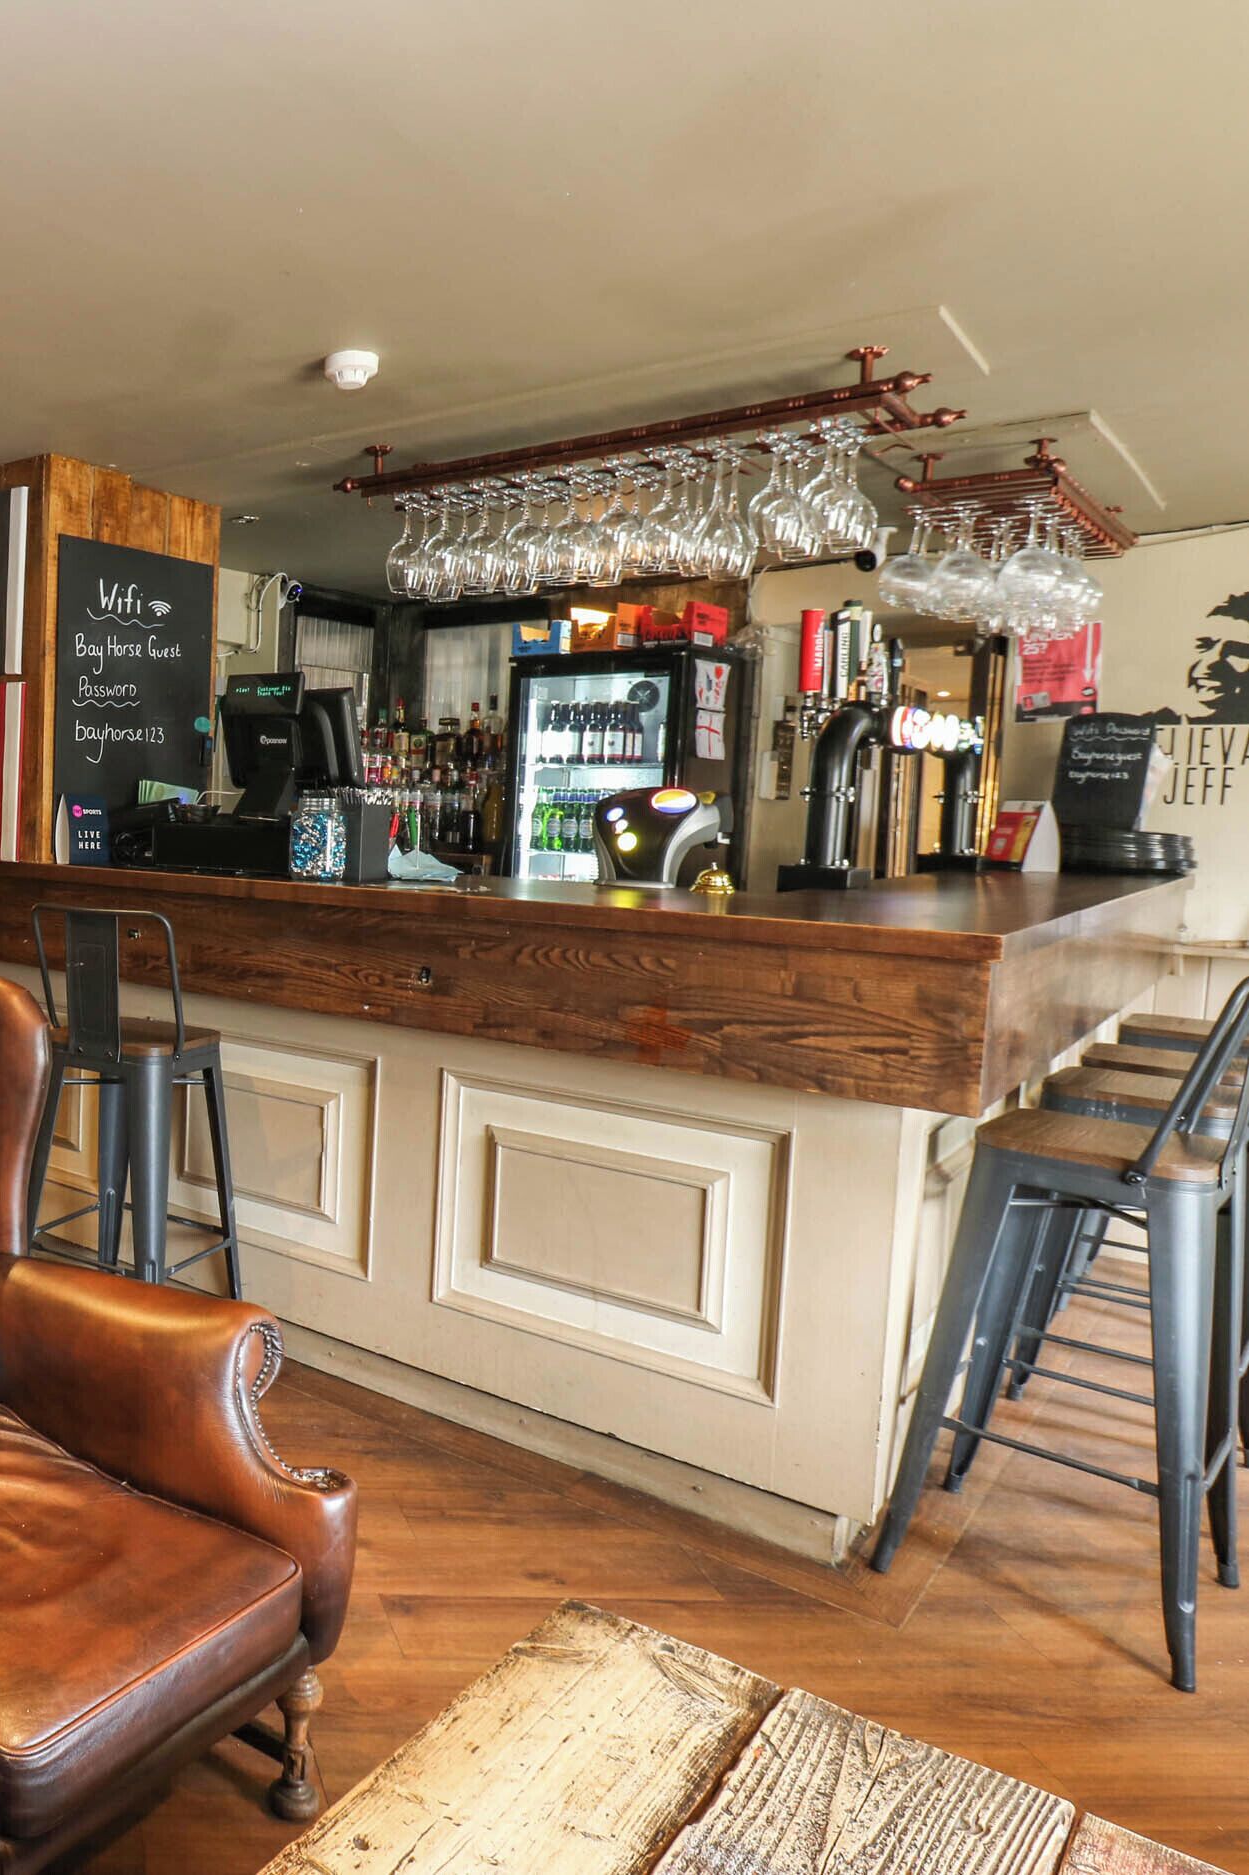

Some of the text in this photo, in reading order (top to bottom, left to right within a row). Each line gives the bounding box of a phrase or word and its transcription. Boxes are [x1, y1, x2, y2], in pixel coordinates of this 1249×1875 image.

[99, 578, 144, 615] Wifi
[75, 632, 182, 675] Bay Horse Guest
[75, 719, 165, 764] bayhorse123
[1163, 767, 1235, 805] JEFF
[78, 830, 101, 839] LIVE
[78, 841, 101, 850] HERE
